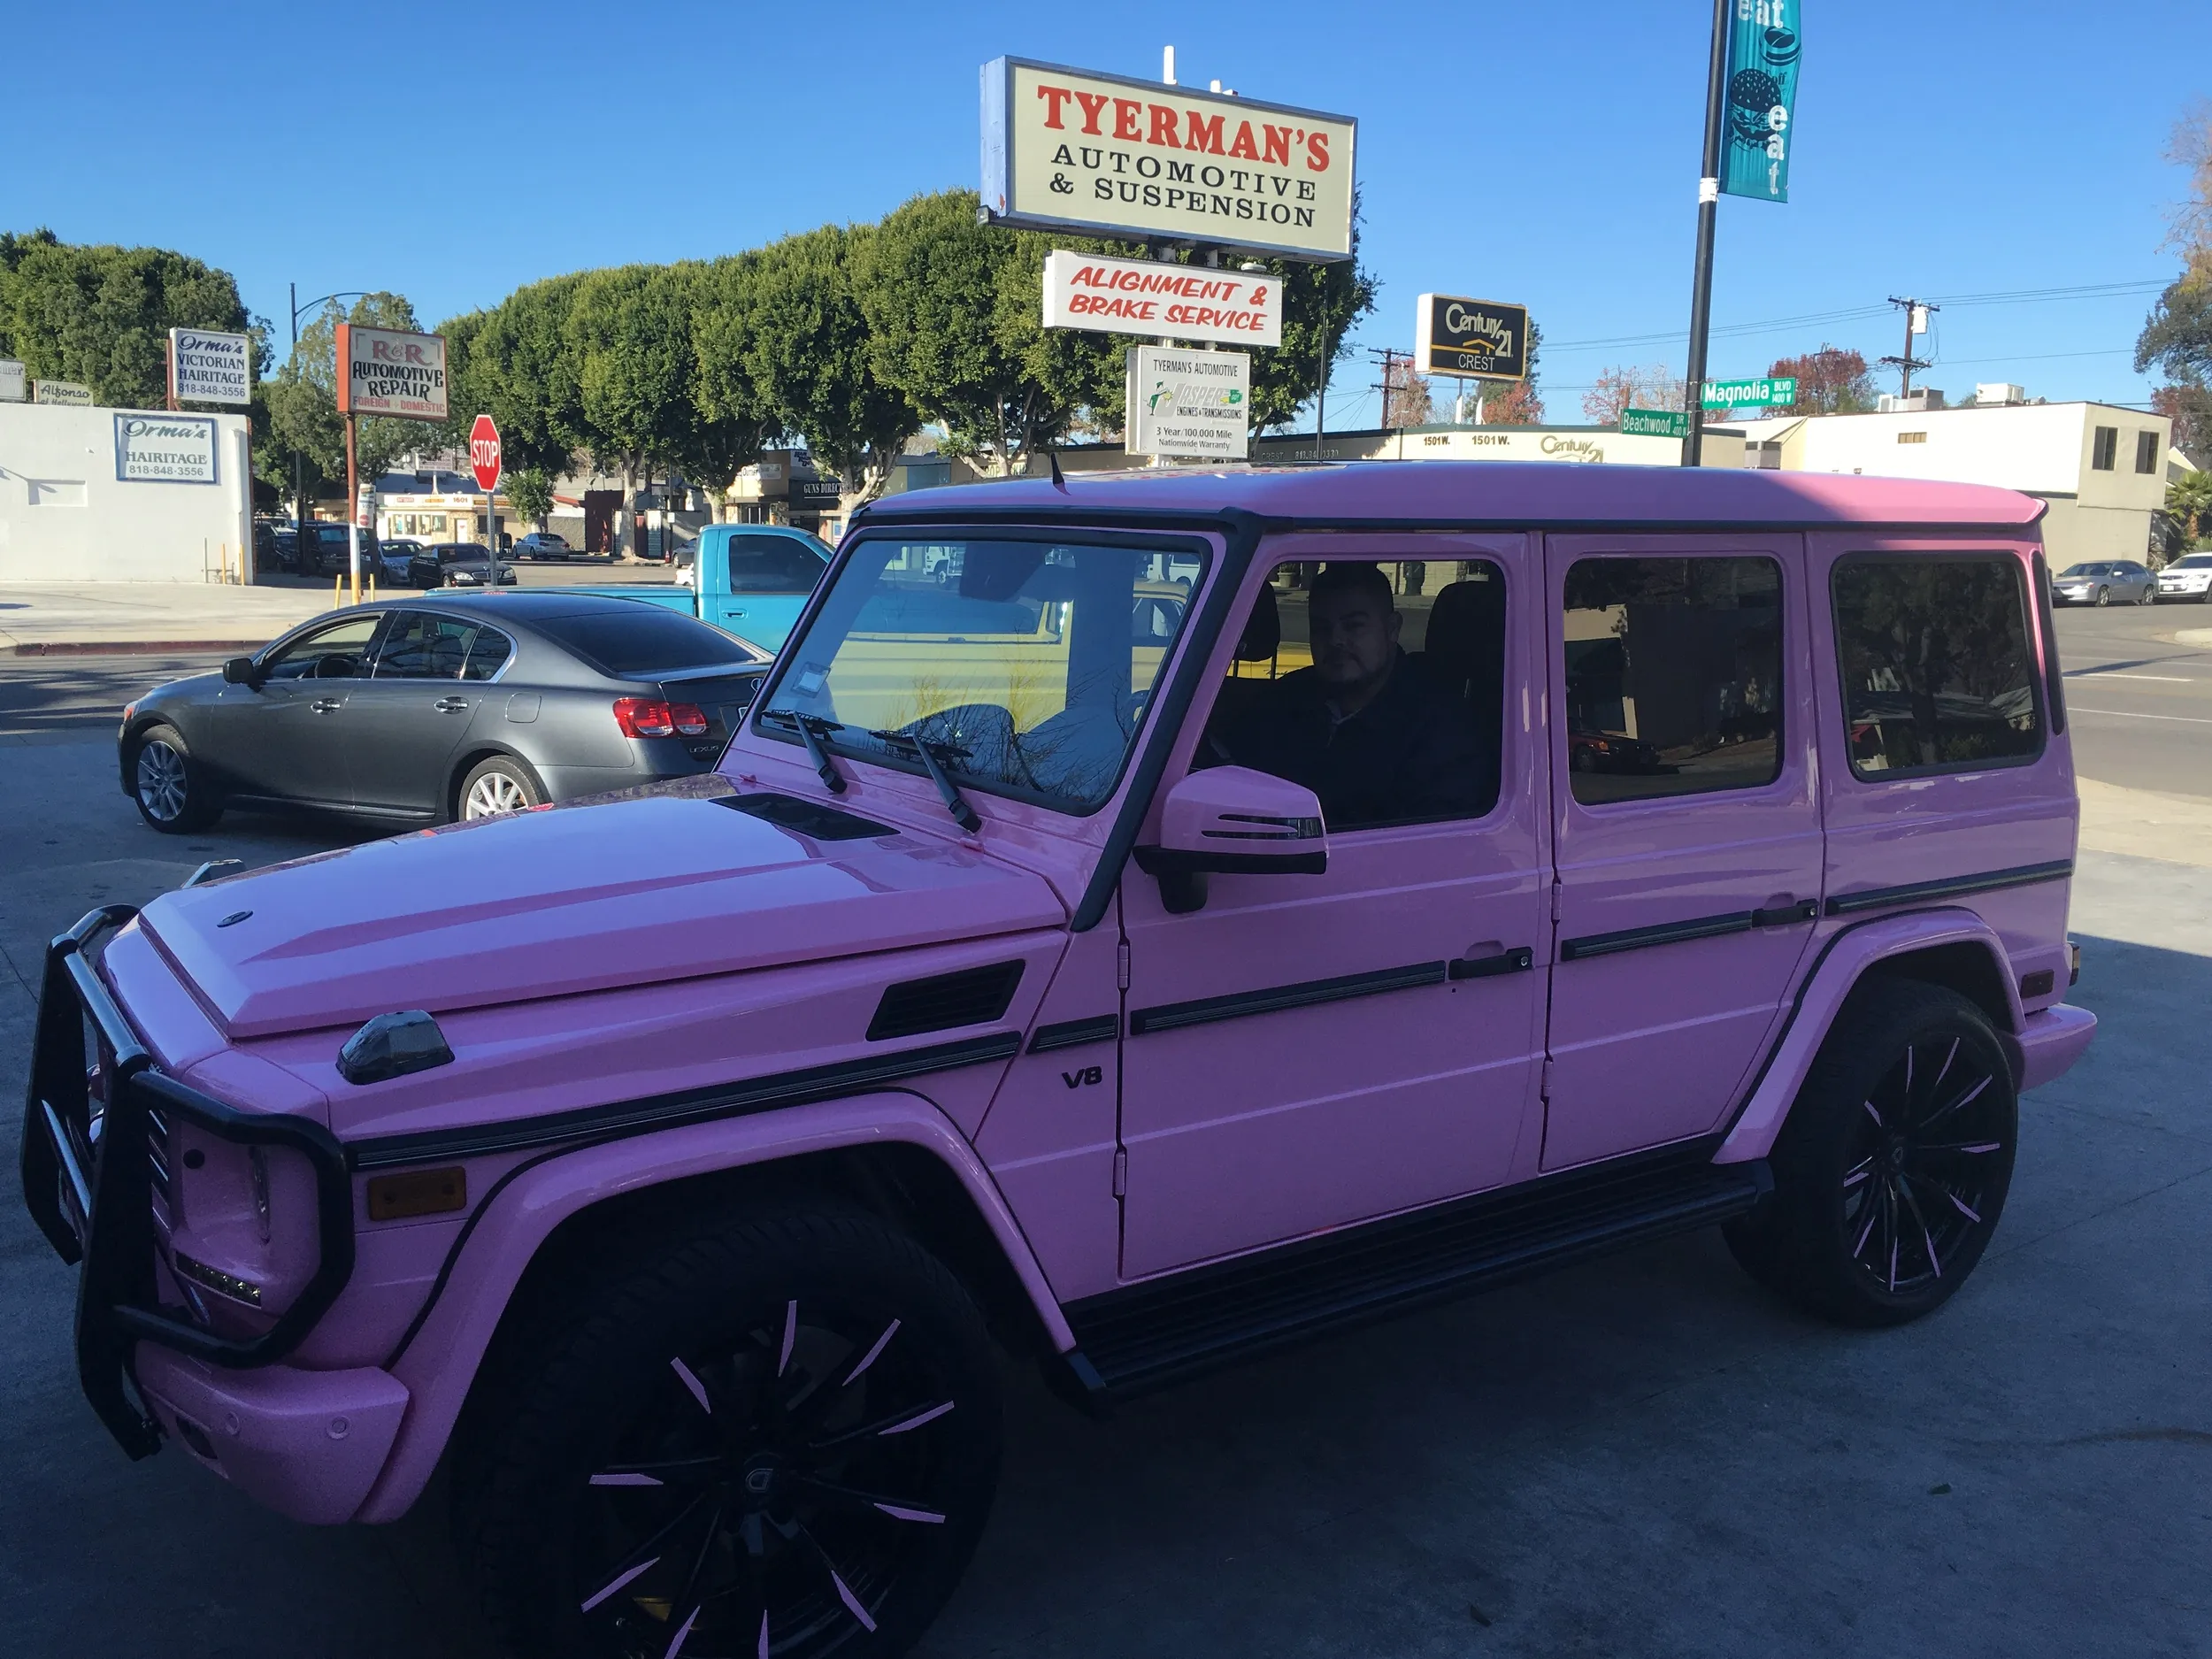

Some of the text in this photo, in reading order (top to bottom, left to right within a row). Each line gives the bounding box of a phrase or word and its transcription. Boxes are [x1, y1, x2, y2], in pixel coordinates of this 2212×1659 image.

[1037, 85, 1330, 173] TYERMAN'S
[1050, 144, 1317, 202] AUTOMOTIVE
[1049, 173, 1316, 228] & SUSPENSION
[1070, 266, 1268, 306] ALIGNMENT &
[1068, 294, 1268, 331] BRAKE SERVICE
[1446, 303, 1512, 357] Century 21
[178, 335, 244, 354] Orma's
[177, 353, 245, 370] VICTORIAN
[1153, 359, 1238, 377] TYERMAN'S AUTOMOTIVE
[1458, 354, 1495, 372] CREST
[179, 368, 246, 385] HAIRITAGE
[352, 361, 444, 388] AUTOMOTIVE
[41, 384, 90, 398] Alfonso
[178, 382, 246, 397] 818-848-3556
[367, 380, 432, 403] REPAIR
[1705, 380, 1792, 408] Magnolia BLVD
[1772, 393, 1792, 403] 1400 W
[352, 396, 445, 413] FOREIGN DOMESTIC
[1177, 406, 1198, 417] ENGINES
[1202, 408, 1242, 419] TRANSMISSIONS
[123, 420, 207, 439] Orma's
[1624, 411, 1684, 434] Beachwood DR
[1682, 426, 1687, 436] N
[1156, 426, 1161, 435] 3
[1216, 430, 1233, 439] Mile
[1424, 436, 1441, 446] 1501
[1471, 435, 1496, 445] 1501
[472, 439, 499, 468] STOP
[1158, 439, 1230, 451] Nationwide Warranty
[1540, 434, 1604, 464] Century 21
[126, 451, 208, 465] HAIRITAGE
[803, 483, 820, 494] GUNS
[1062, 1065, 1102, 1088] V8
